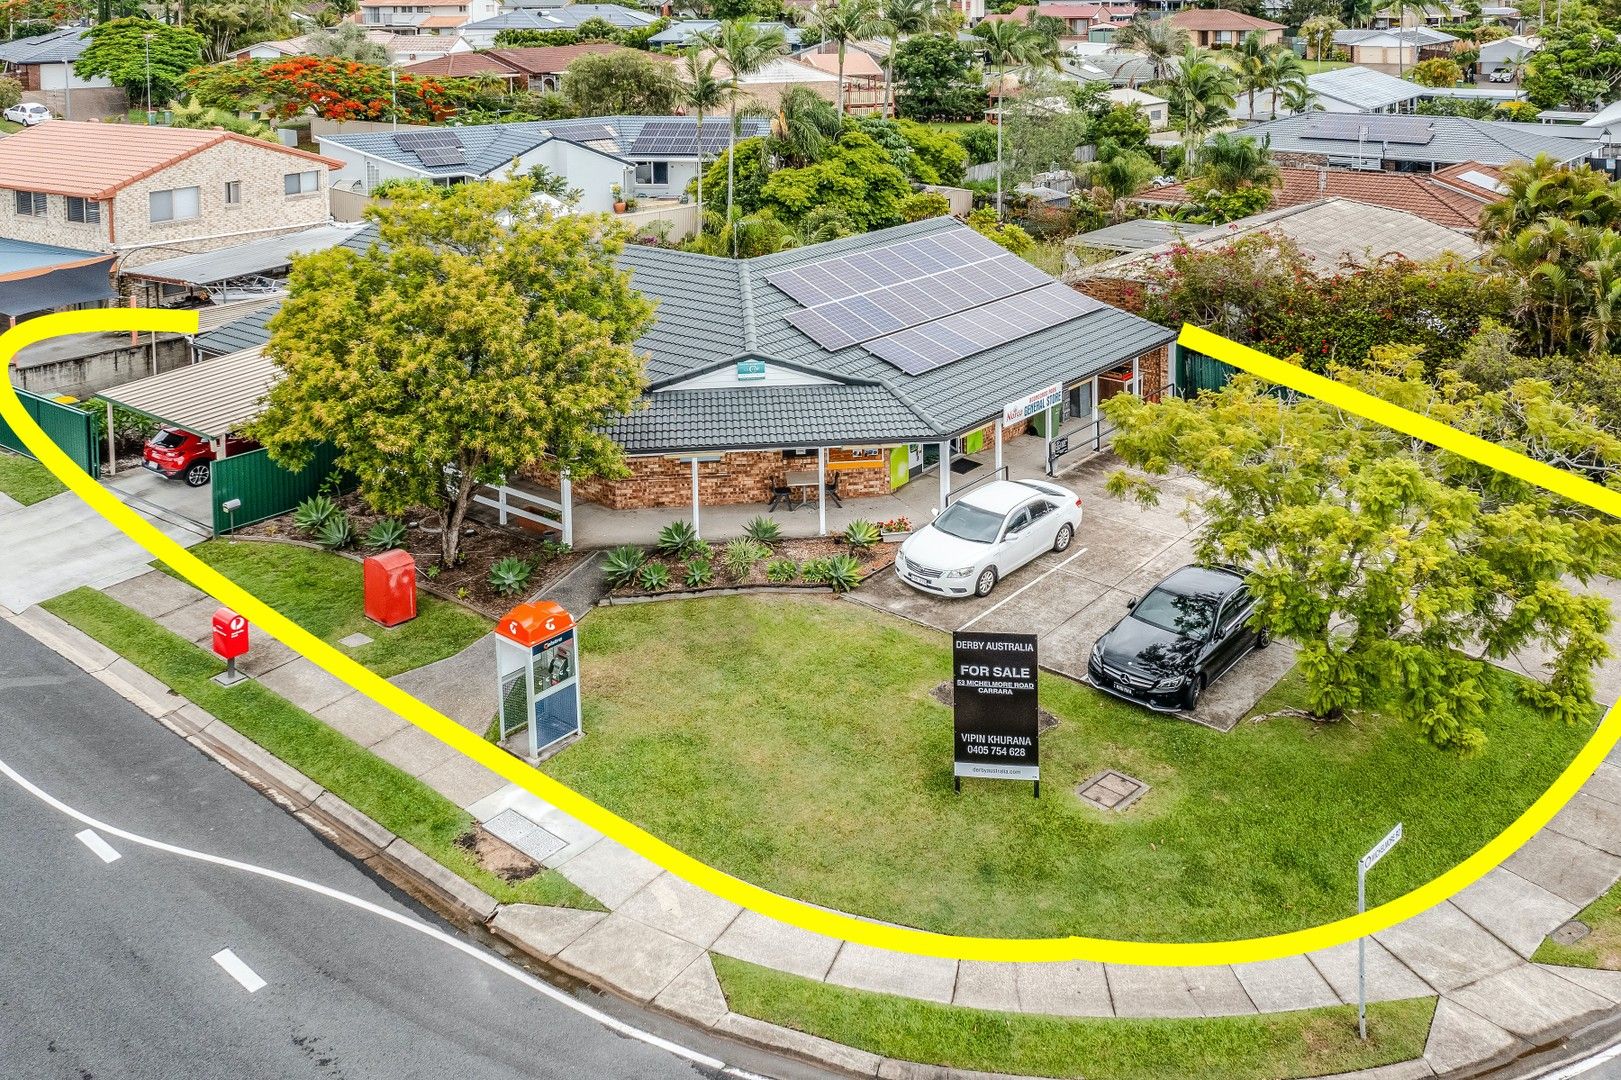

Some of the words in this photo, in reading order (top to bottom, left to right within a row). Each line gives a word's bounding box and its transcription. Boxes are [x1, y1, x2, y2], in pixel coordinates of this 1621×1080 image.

[1024, 398, 1045, 416] GENERAL
[1046, 391, 1062, 406] STORE
[956, 640, 984, 650] DERBY
[985, 641, 1034, 652] AUSTRALIA
[960, 665, 990, 677] FOR
[992, 667, 1030, 679] SALE
[966, 680, 1013, 688] MICHELMORE
[978, 687, 1013, 695] CARRARA
[961, 733, 986, 744] VIPIN
[987, 735, 1032, 746] KHURANA
[967, 745, 989, 755] 0405
[990, 746, 1007, 756] 754
[1009, 747, 1026, 757] 628
[972, 767, 1022, 776] derbyaustralia.com
